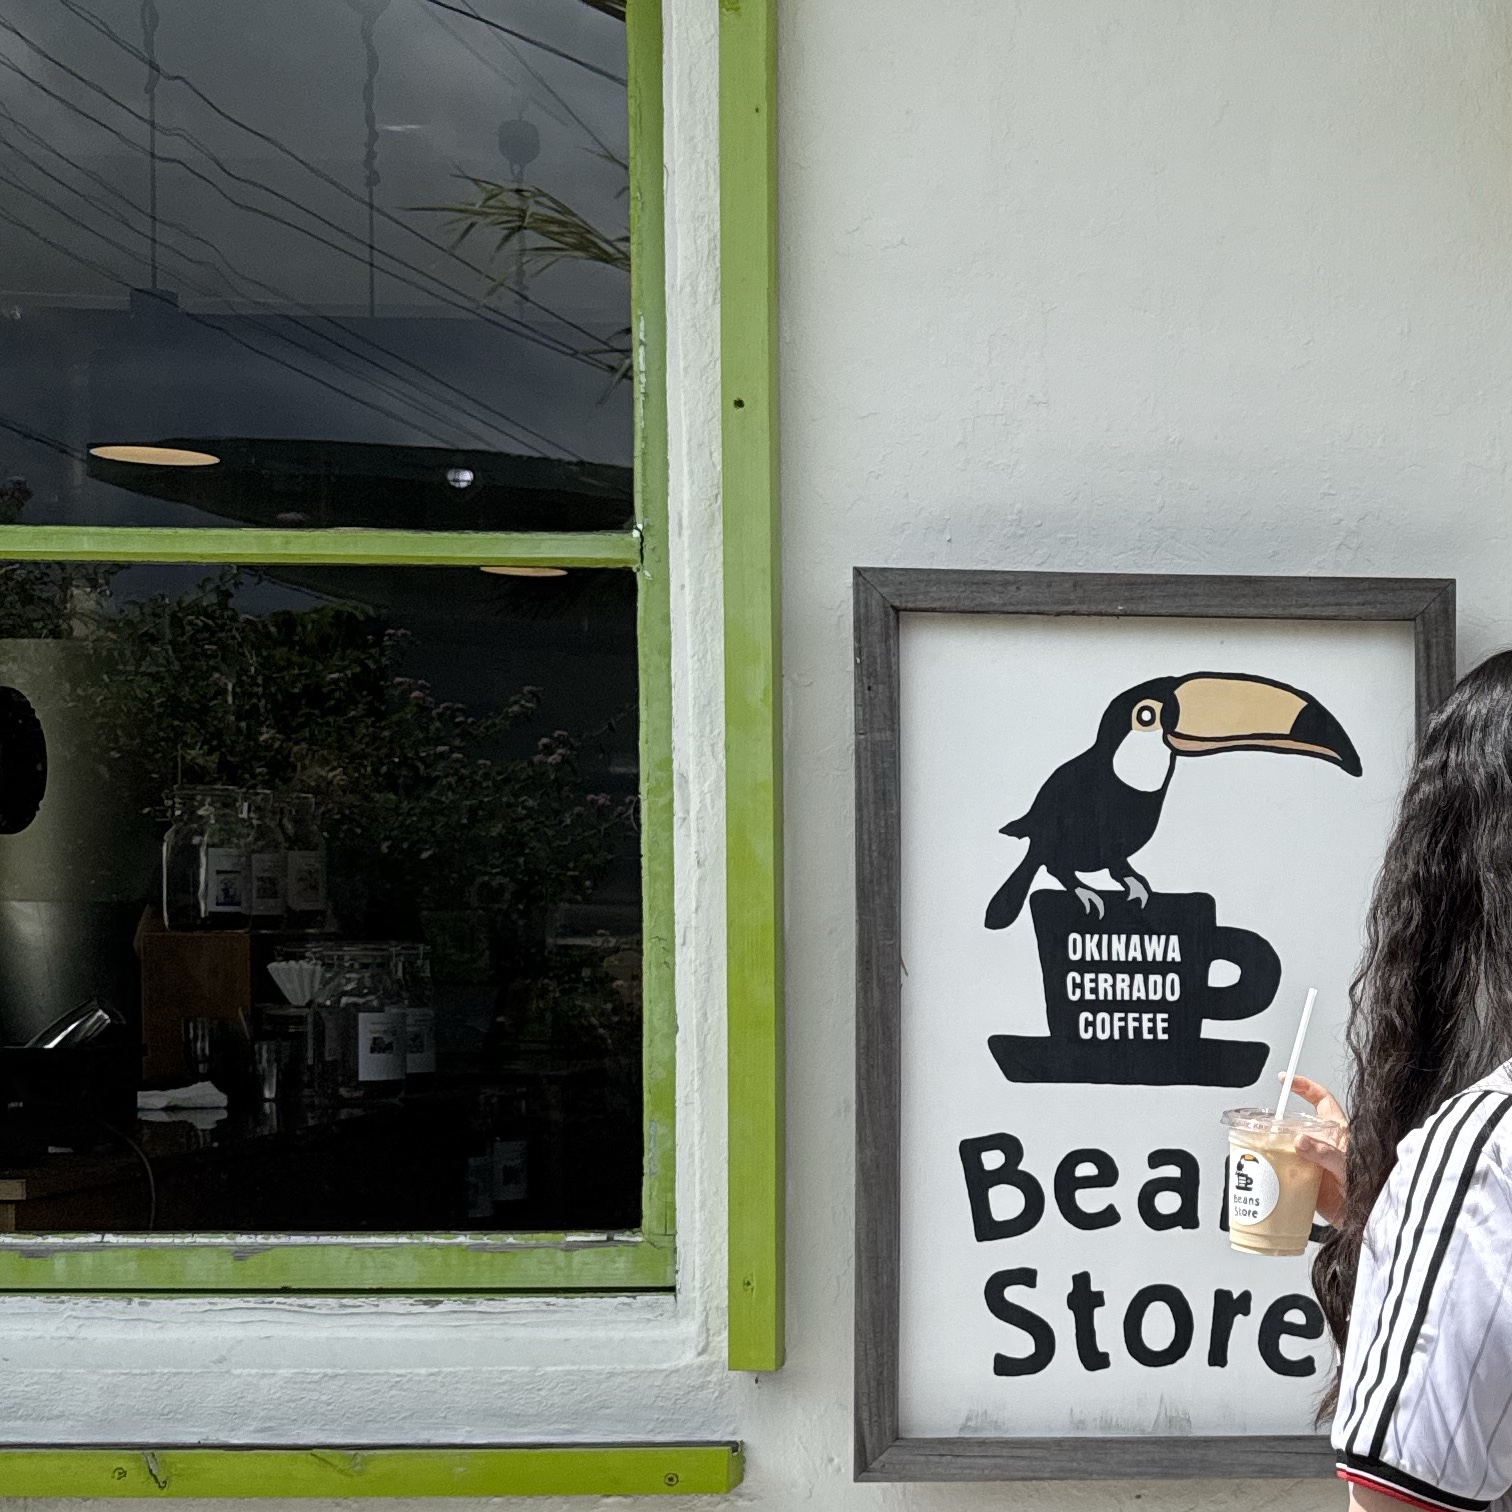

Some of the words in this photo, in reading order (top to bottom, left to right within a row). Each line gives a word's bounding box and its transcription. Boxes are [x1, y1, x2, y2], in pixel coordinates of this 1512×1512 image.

[1067, 932, 1182, 962] OKINAWA
[1066, 971, 1182, 1002] CERRADO
[1078, 1011, 1169, 1041] COFFEE
[958, 1132, 1337, 1244] Bea
[1233, 1193, 1260, 1207] Beans
[1234, 1206, 1259, 1218] Store
[983, 1267, 1325, 1378] Store
